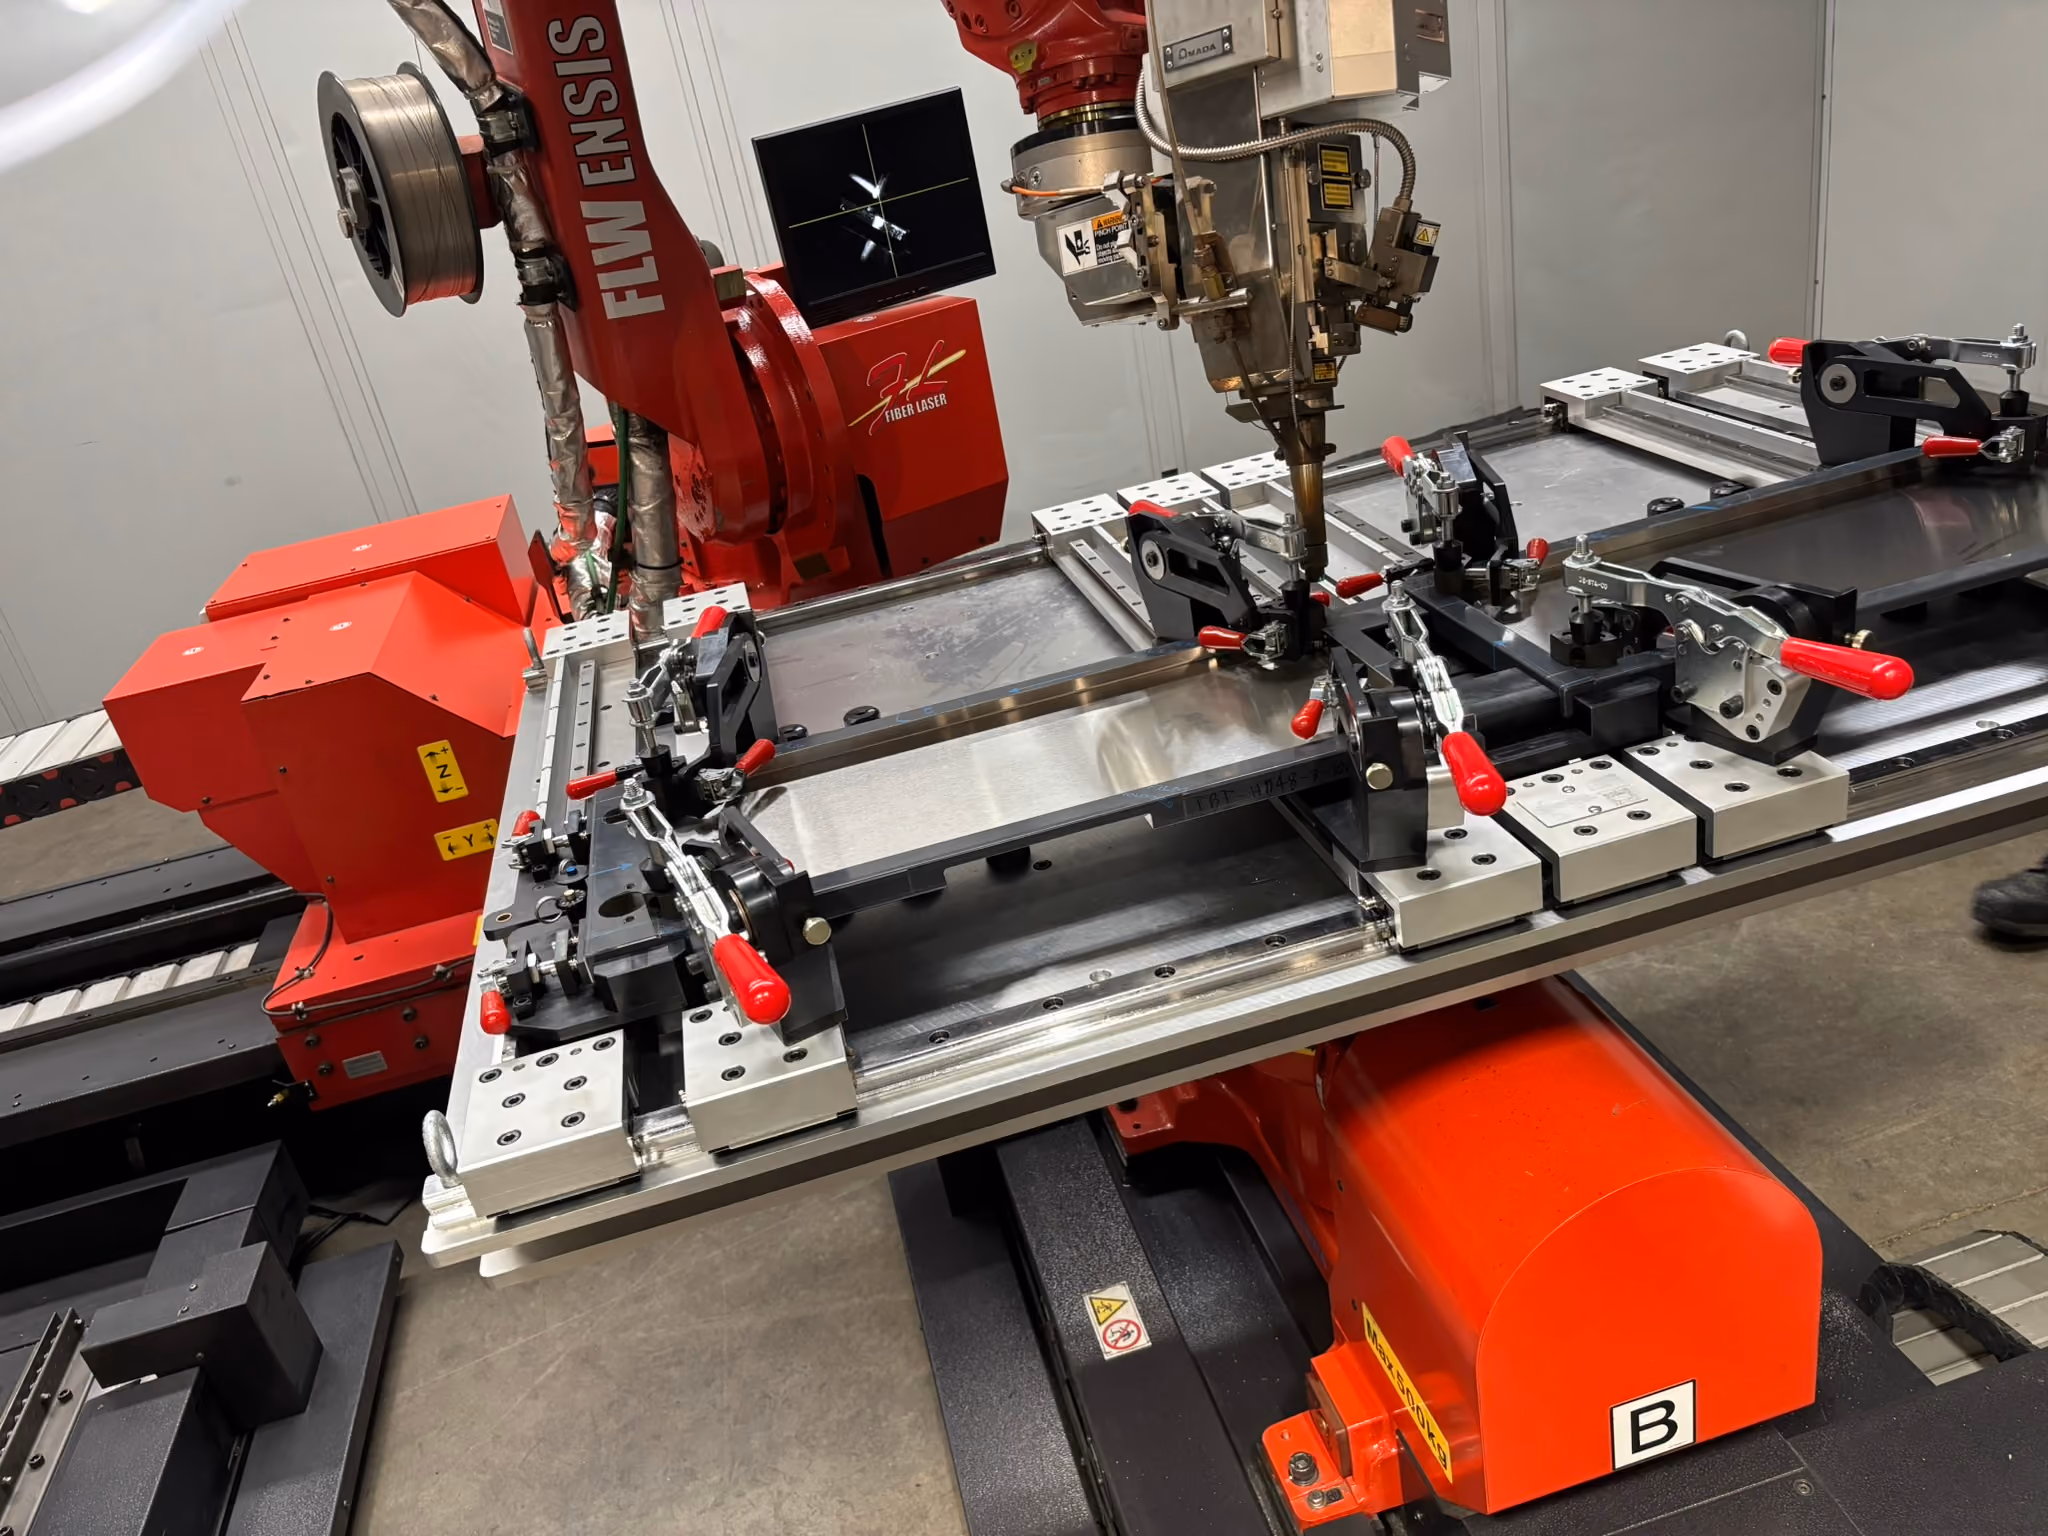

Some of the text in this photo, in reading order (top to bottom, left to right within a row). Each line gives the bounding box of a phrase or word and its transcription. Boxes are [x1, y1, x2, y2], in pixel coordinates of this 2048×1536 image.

[547, 15, 665, 319] FLW ENSIS
[1094, 222, 1128, 237] PINCH POINT
[884, 393, 947, 423] FIBER LASER
[436, 764, 452, 779] Z
[462, 833, 474, 847] Y
[1365, 1317, 1395, 1381] Max
[1630, 1399, 1678, 1455] B
